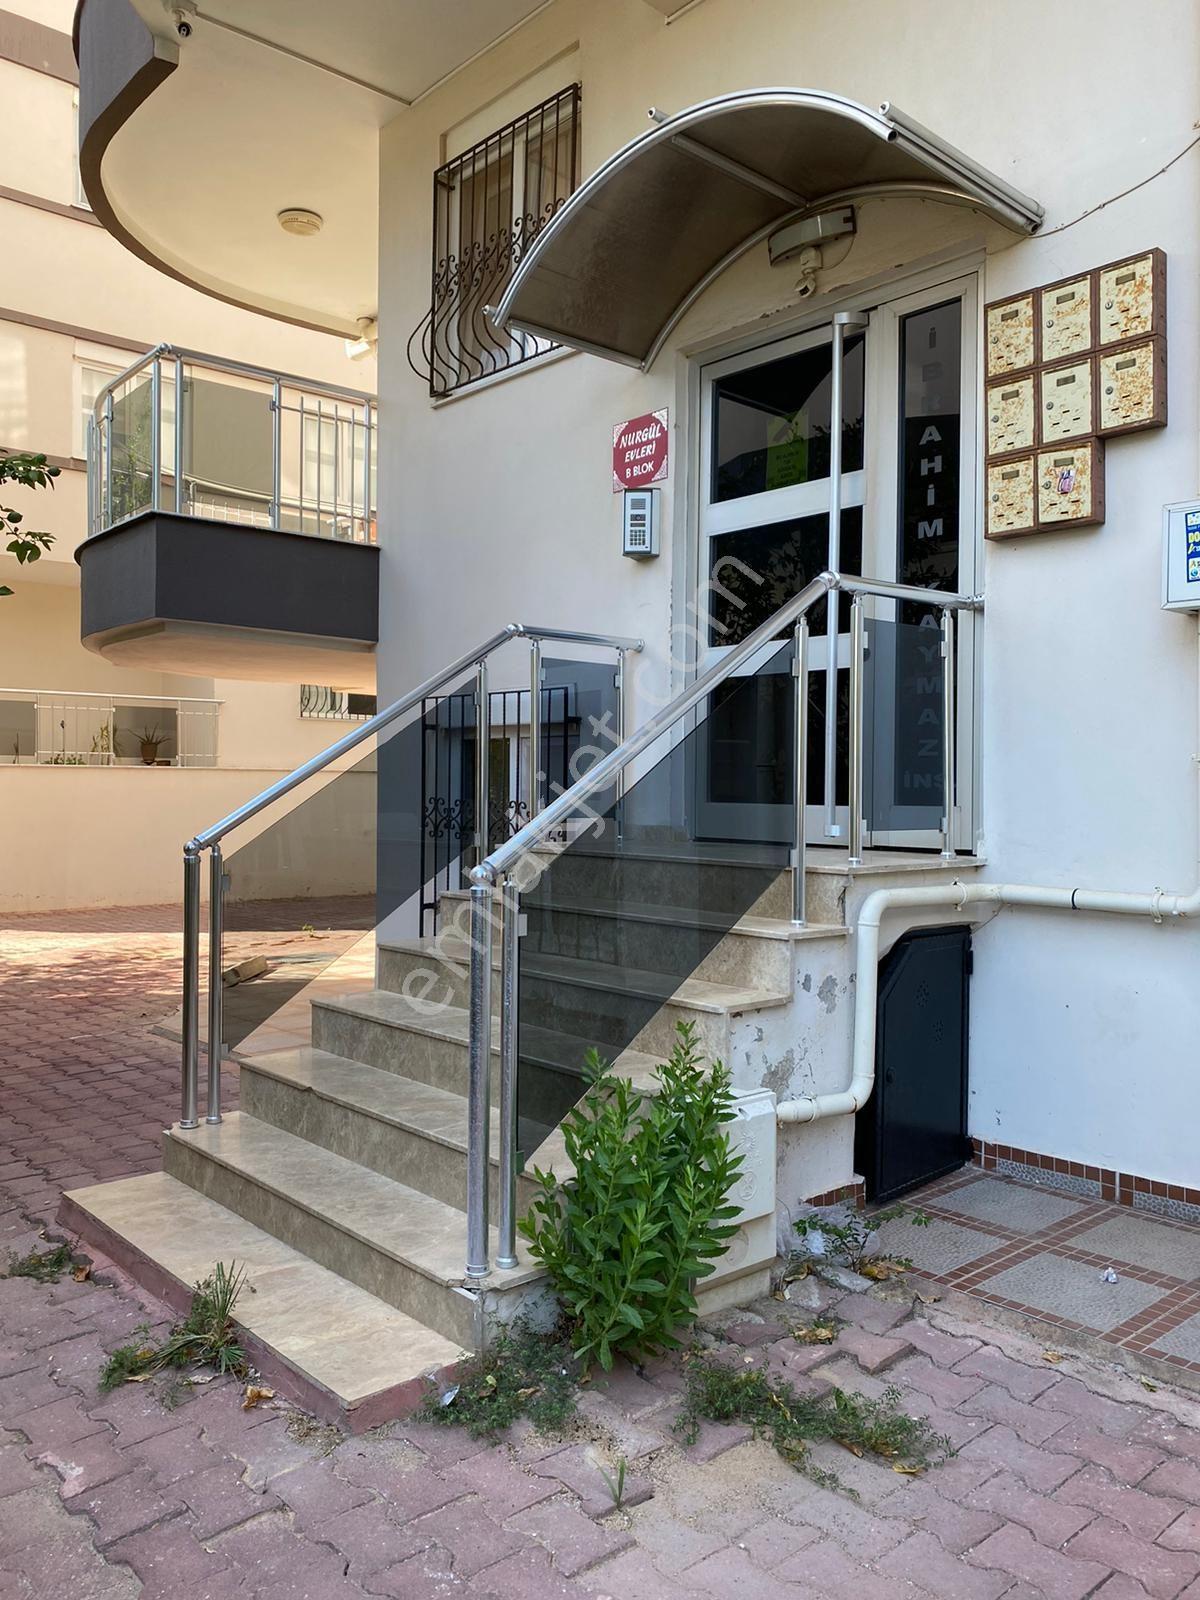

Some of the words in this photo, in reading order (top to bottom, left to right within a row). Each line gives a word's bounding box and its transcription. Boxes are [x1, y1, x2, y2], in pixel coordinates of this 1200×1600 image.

[619, 422, 661, 448] NURGÜL
[625, 468, 631, 478] B
[633, 461, 654, 476] BLOK
